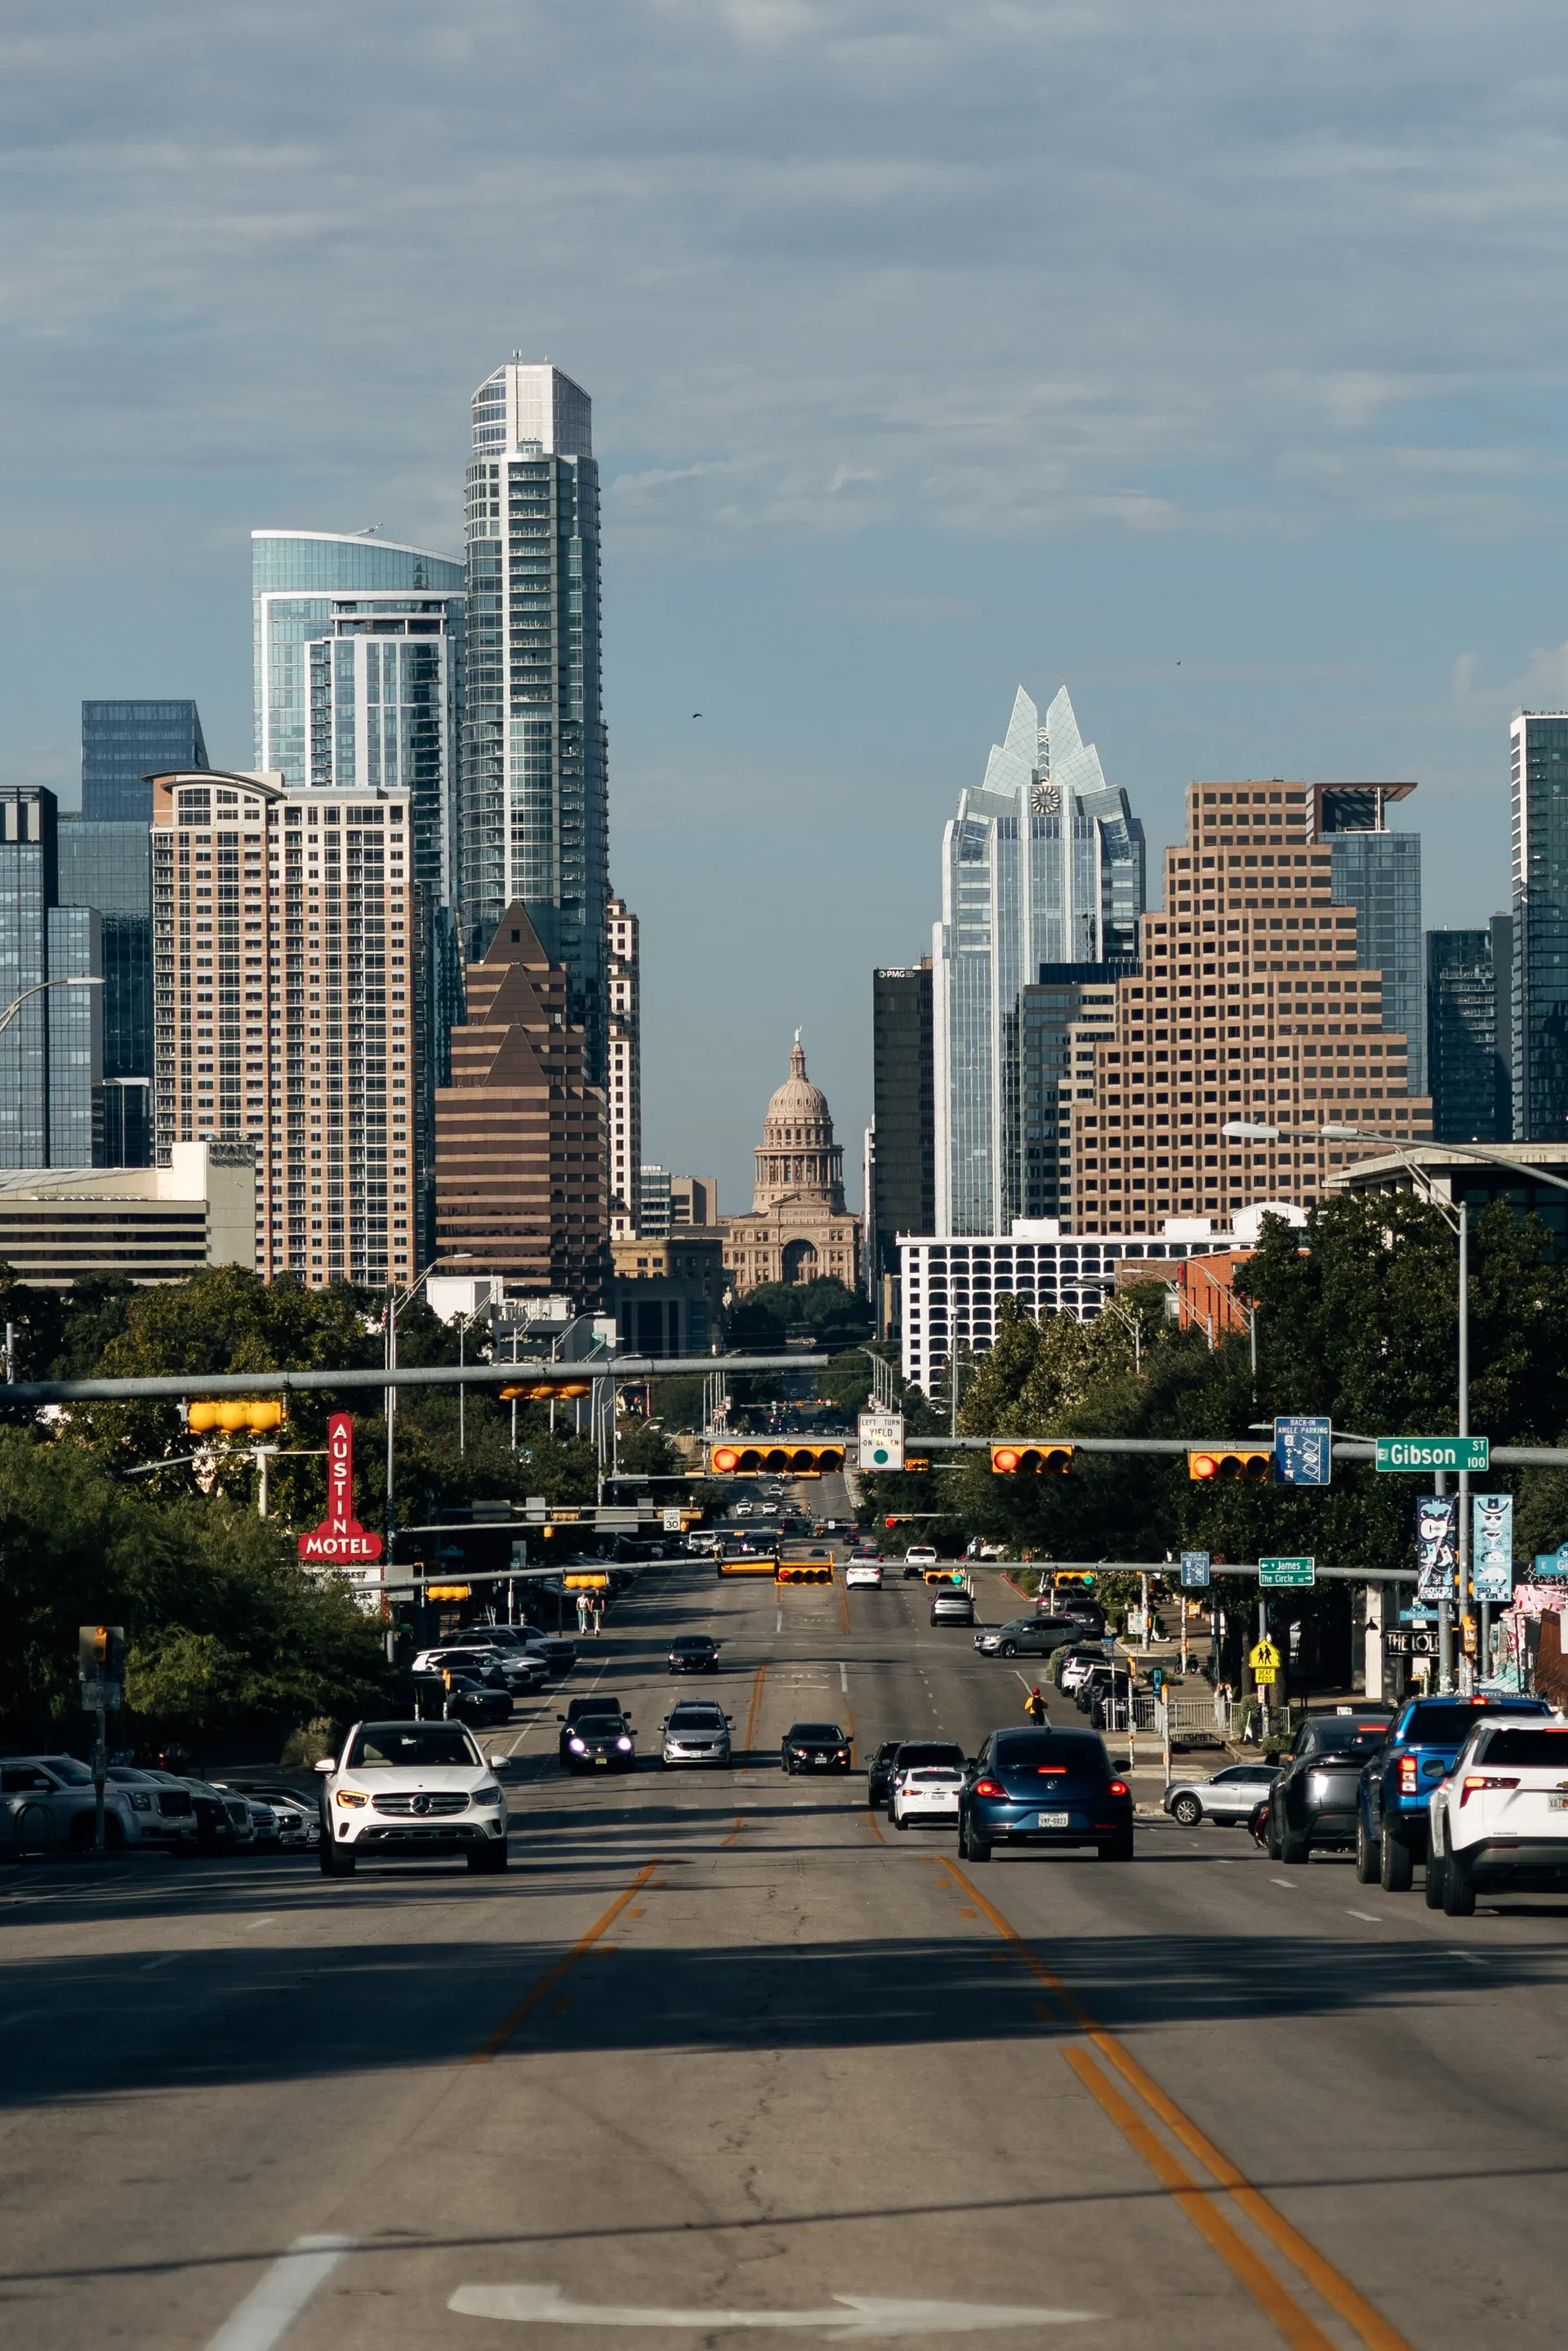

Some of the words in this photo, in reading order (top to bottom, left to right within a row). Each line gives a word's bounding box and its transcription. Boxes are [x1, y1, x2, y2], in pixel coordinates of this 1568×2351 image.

[209, 1144, 253, 1154] HYATT
[209, 1157, 252, 1165] REGENCY
[870, 1428, 893, 1437] YIELD
[1378, 1449, 1385, 1461] E
[1391, 1443, 1455, 1465] Gibson
[1472, 1440, 1485, 1451] ST
[1468, 1457, 1486, 1468] 100
[332, 1423, 348, 1534] AUSTIN
[666, 1520, 679, 1528] 30
[305, 1537, 373, 1555] MOTEL
[1276, 1561, 1300, 1570] James
[1541, 1561, 1547, 1569] E
[1261, 1574, 1272, 1583] The
[1275, 1574, 1294, 1583] Circle
[1386, 1634, 1409, 1651] THE
